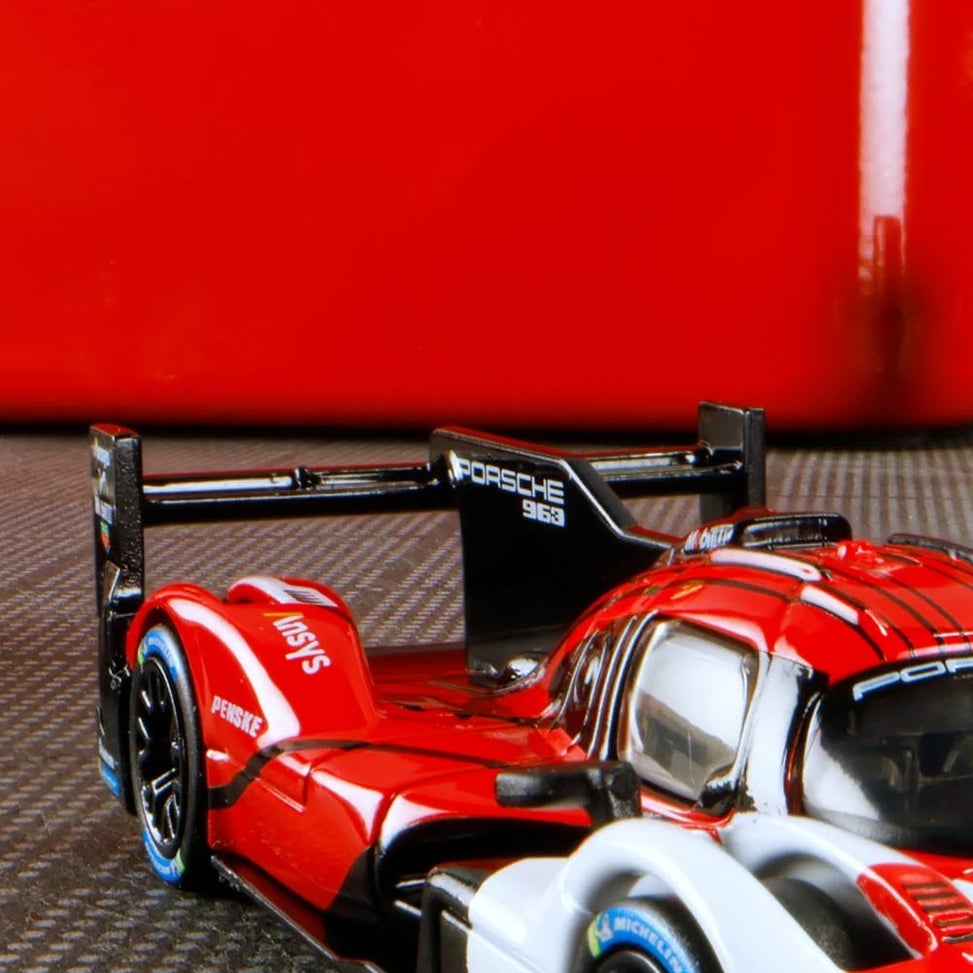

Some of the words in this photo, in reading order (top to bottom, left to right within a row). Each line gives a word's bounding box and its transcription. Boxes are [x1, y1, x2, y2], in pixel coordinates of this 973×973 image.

[454, 457, 565, 505] PORSCHE
[522, 499, 566, 528] 963
[211, 694, 264, 738] PENSKE
